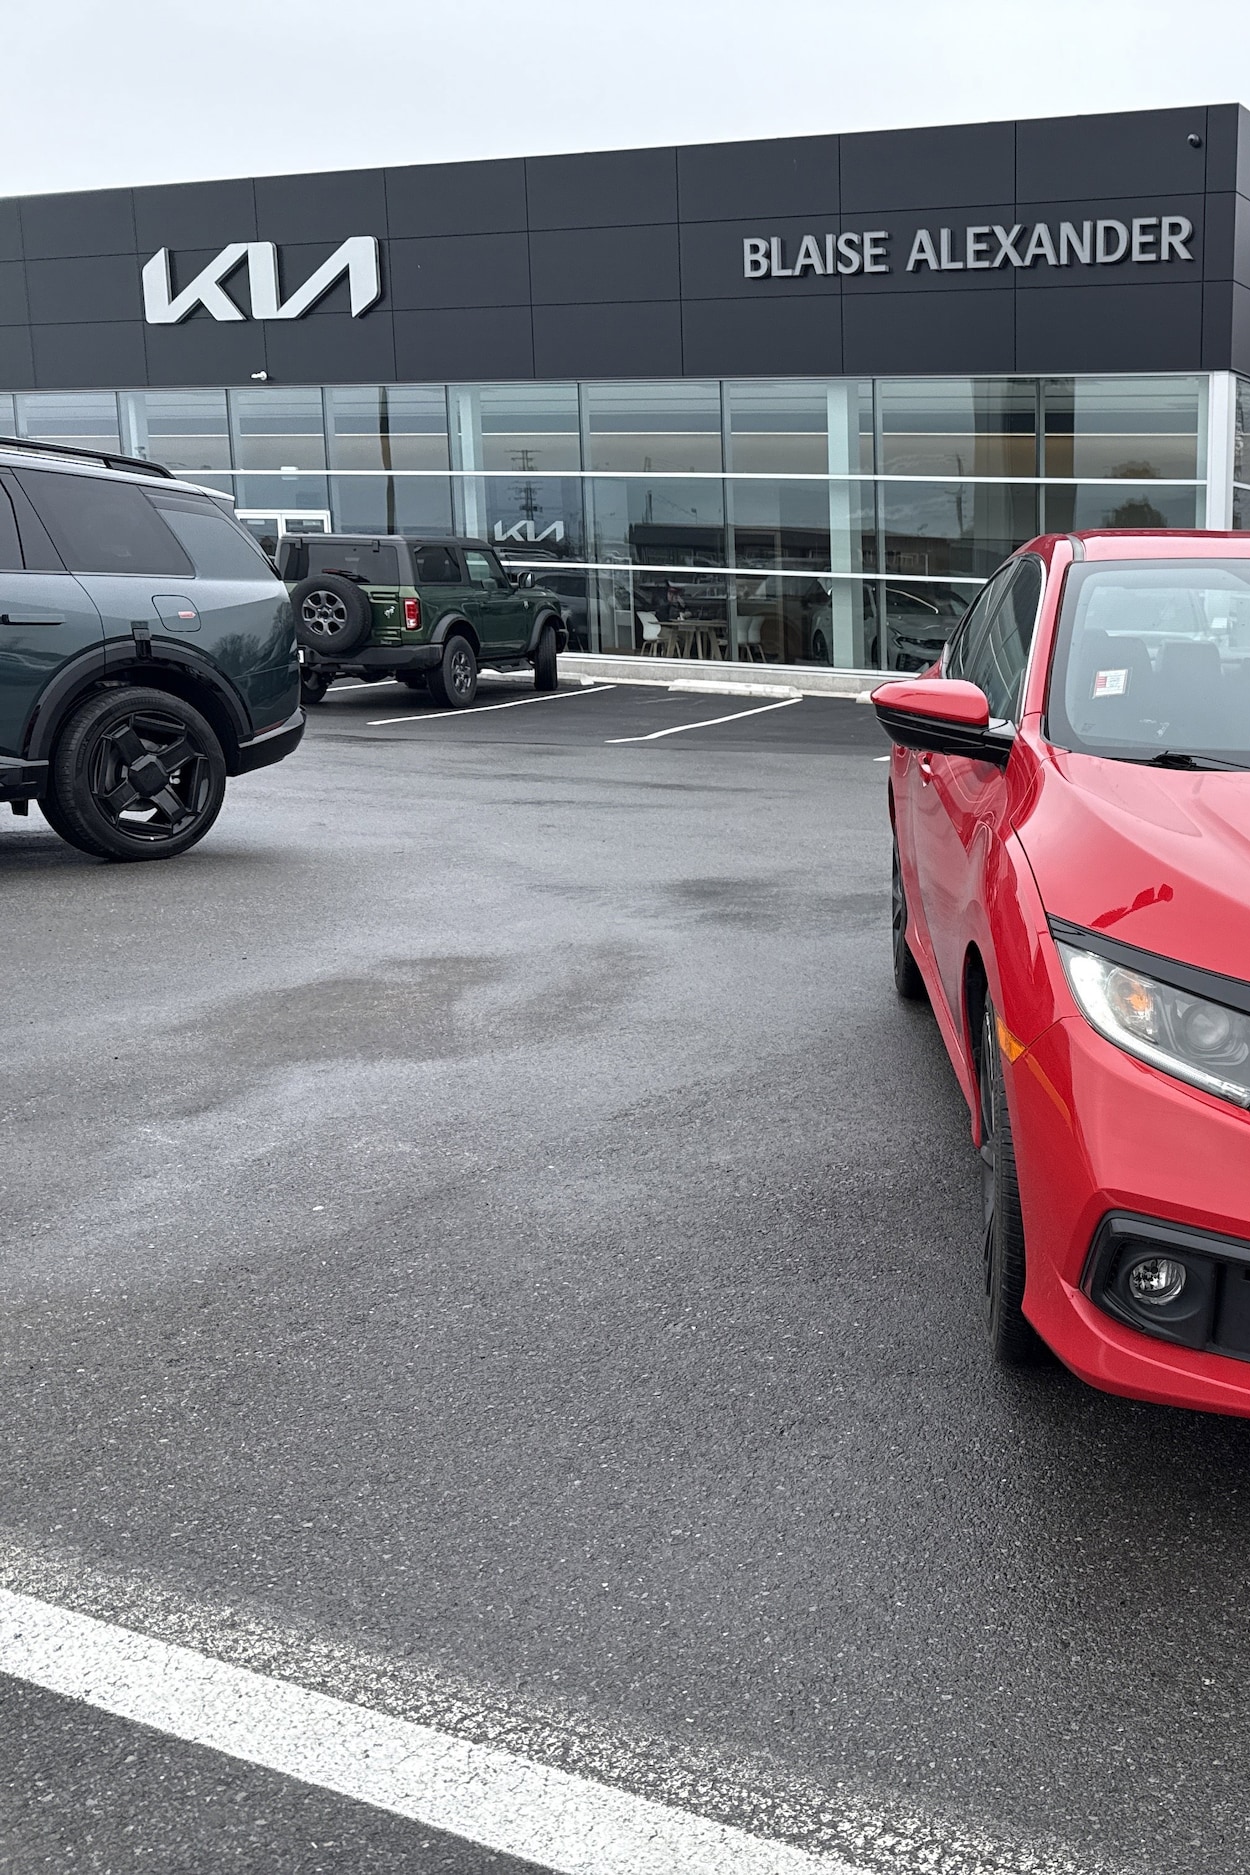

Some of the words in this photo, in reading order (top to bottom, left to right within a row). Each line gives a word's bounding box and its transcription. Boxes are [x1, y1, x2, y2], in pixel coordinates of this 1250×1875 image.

[742, 231, 889, 278] BLAISE
[906, 215, 1194, 272] ALEXANDER
[142, 235, 381, 324] KIA
[495, 520, 564, 542] KIA
